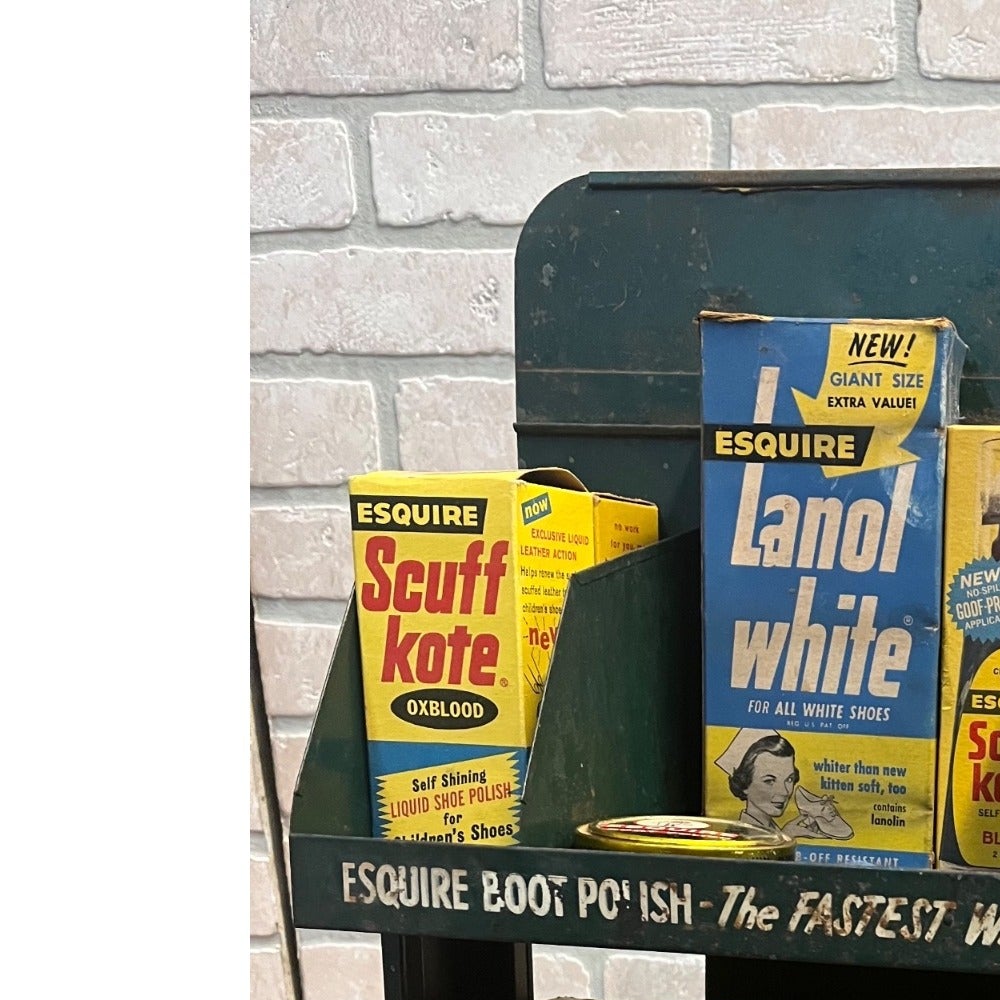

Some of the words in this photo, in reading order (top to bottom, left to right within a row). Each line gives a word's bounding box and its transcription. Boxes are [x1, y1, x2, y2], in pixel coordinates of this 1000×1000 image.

[848, 332, 917, 359] NEW!
[830, 371, 882, 387] GIANT
[892, 373, 924, 388] SIZE
[827, 397, 866, 408] EXTRA
[715, 430, 855, 459] ESQUIRE
[357, 502, 480, 527] ESQUIRE
[524, 497, 548, 519] now
[531, 528, 566, 542] EXCLUSIVE
[568, 533, 589, 546] LIQUID
[521, 546, 550, 558] LEATHER
[553, 549, 577, 561] ACTION
[361, 535, 509, 615] Scuff
[521, 566, 537, 579] Helps
[522, 585, 541, 595] scuffed
[543, 585, 561, 596] leather
[731, 576, 913, 698] white
[381, 615, 500, 686] kote
[406, 699, 484, 720] OXBLOOD
[748, 700, 769, 714] FOR
[775, 703, 796, 716] ALL
[803, 703, 844, 719] WHITE
[850, 706, 891, 722] SHOES
[814, 759, 852, 775] whiter
[854, 760, 879, 776] than
[883, 765, 907, 777] new
[412, 777, 438, 793] Self
[441, 769, 487, 789] Shining
[821, 776, 854, 791] kitten
[888, 783, 907, 795] too
[390, 798, 430, 818] LIQUID
[434, 790, 466, 809] SHOE
[469, 782, 513, 802] POLISH
[874, 803, 907, 813] contains
[443, 811, 463, 825] for
[871, 814, 905, 827] lanolin
[978, 808, 1000, 817] SELF
[470, 823, 514, 841] Shoes
[341, 862, 469, 910] ESQUIRE
[481, 870, 568, 917] BOOT
[717, 884, 779, 931] The
[789, 890, 957, 942] FASTEST
